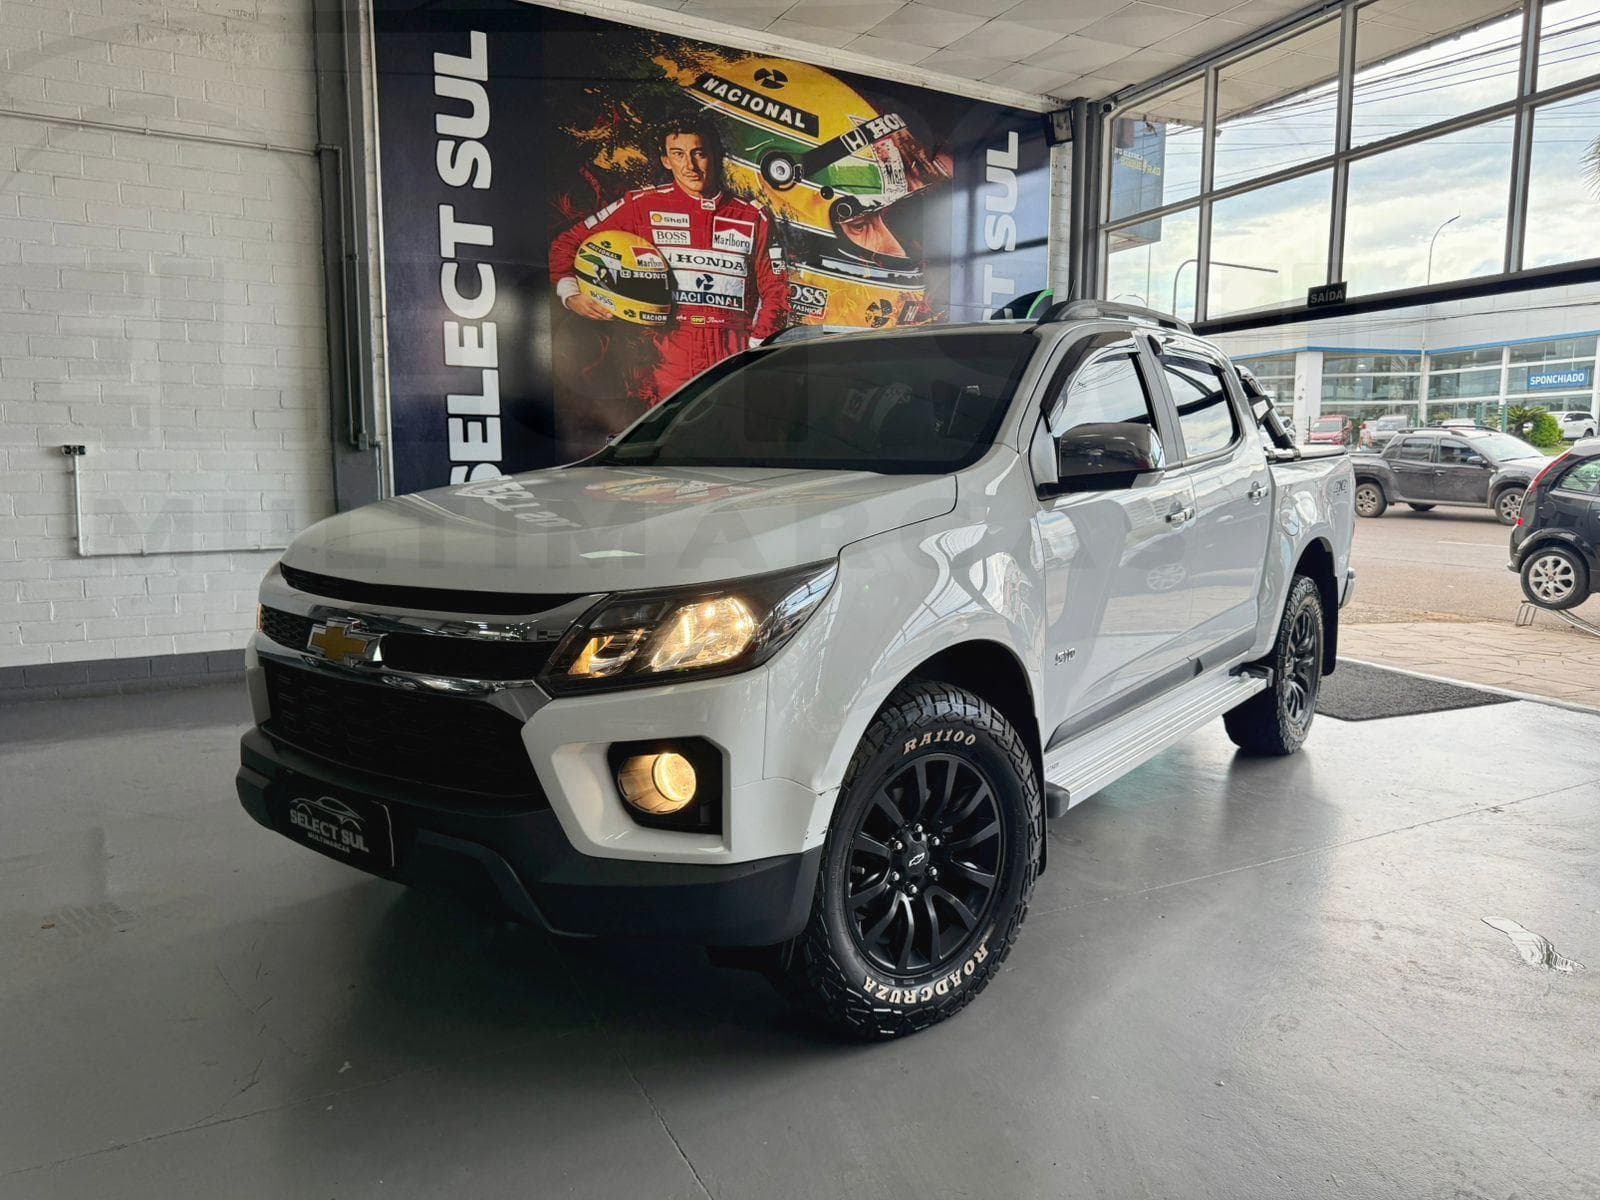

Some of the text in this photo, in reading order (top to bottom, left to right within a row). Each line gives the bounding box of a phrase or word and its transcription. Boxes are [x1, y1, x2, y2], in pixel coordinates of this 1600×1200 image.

[433, 30, 491, 189] SUL
[702, 78, 806, 128] NACIONAL
[984, 131, 1019, 251] SUL
[663, 216, 689, 224] Shell
[656, 231, 688, 240] BOSS
[714, 233, 750, 250] Marlboro
[676, 254, 745, 272] HONDA
[789, 283, 827, 305] OSS
[1529, 373, 1585, 385] SPONCHIADO
[903, 729, 976, 755] RA1100
[289, 808, 370, 853] SELECT SUL
[862, 943, 989, 1004] ROADCRUZA
